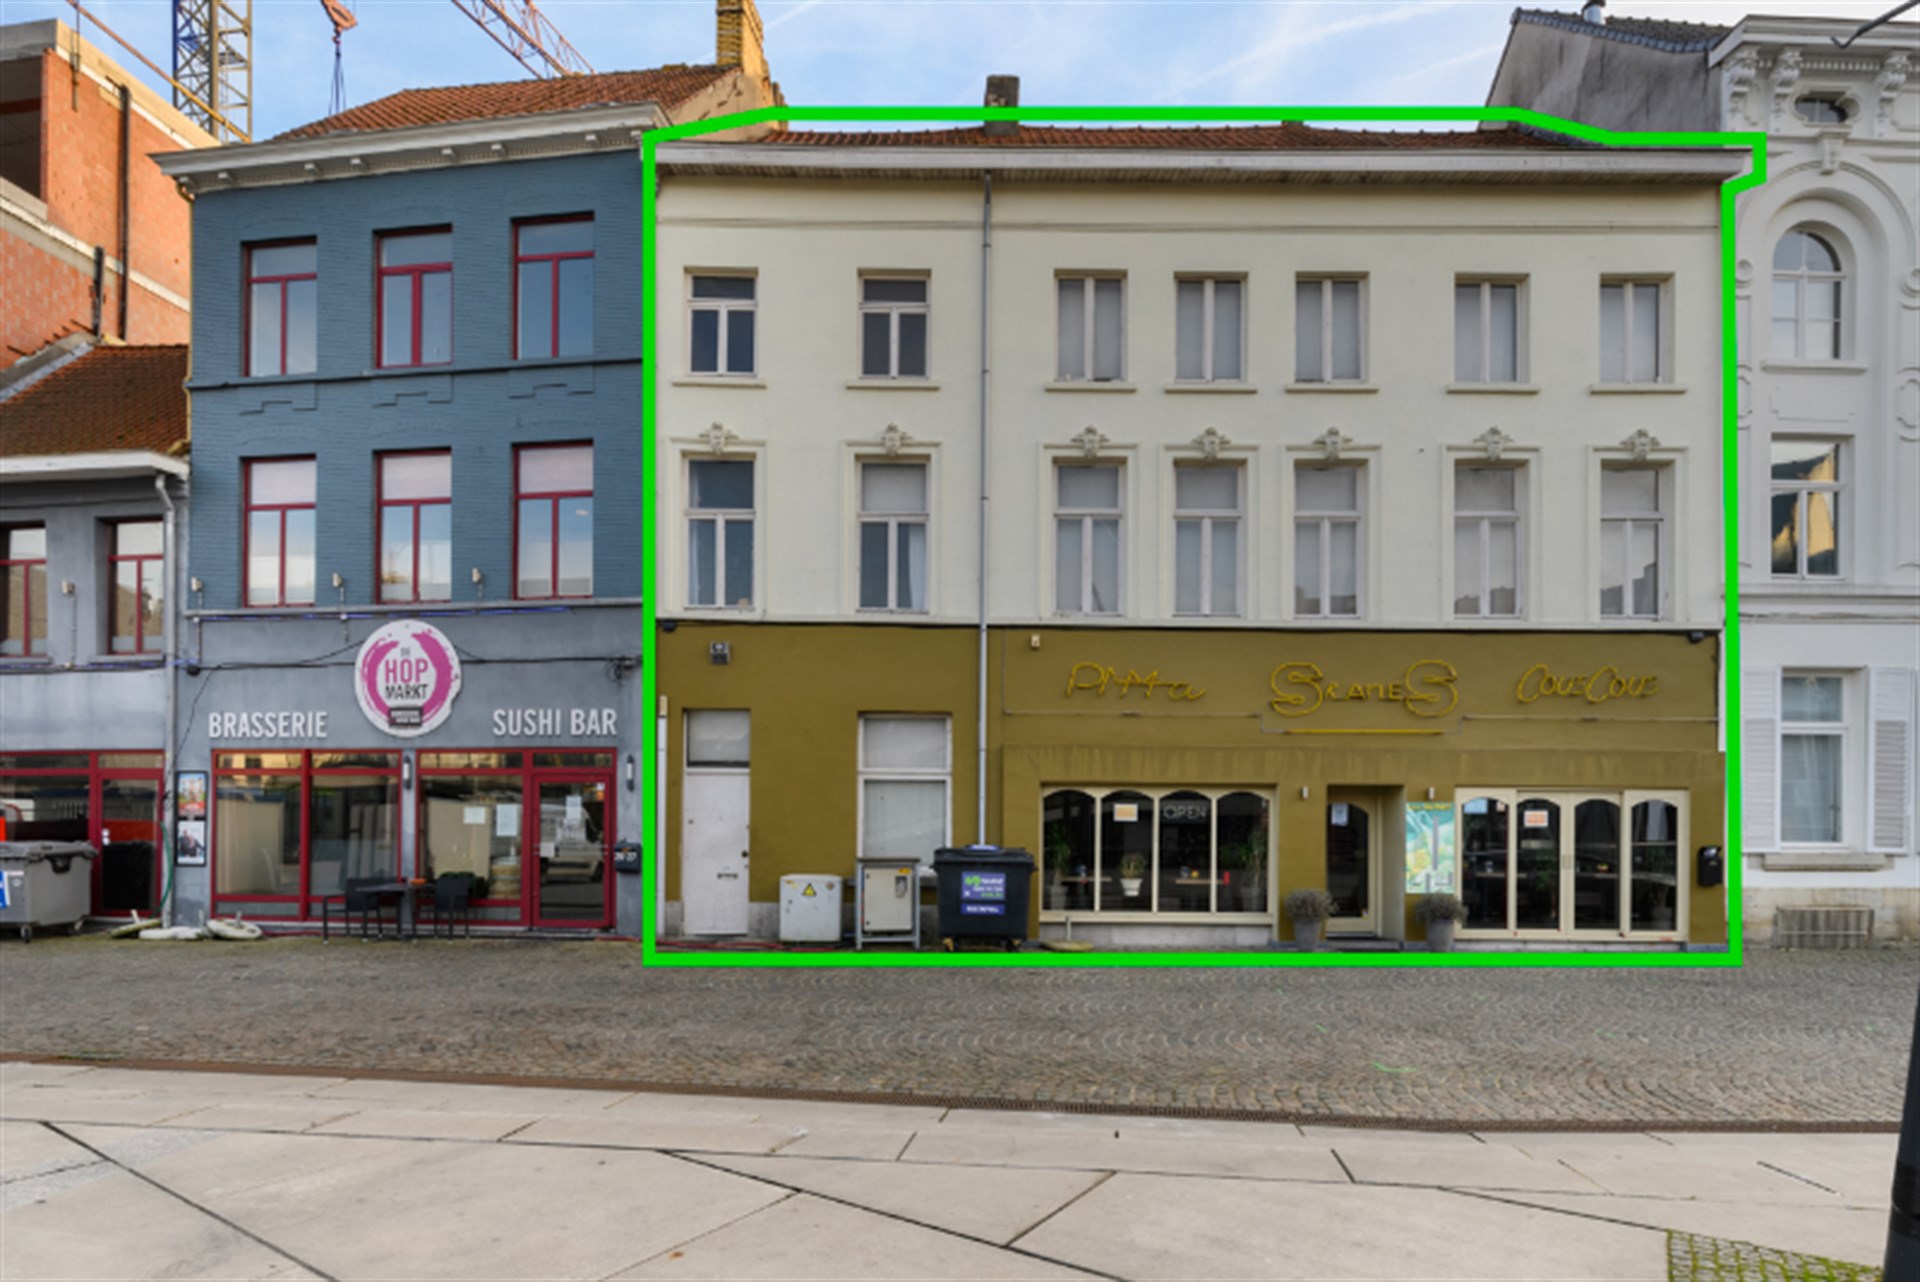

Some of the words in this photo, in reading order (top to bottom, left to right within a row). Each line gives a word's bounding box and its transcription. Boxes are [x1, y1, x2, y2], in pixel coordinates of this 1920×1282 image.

[385, 658, 429, 684] HOP
[385, 683, 429, 700] MARKT
[208, 710, 328, 738] BRASSERIE
[493, 708, 562, 736] SUSHI
[570, 708, 618, 736] BAR
[1164, 804, 1207, 820] OPEN
